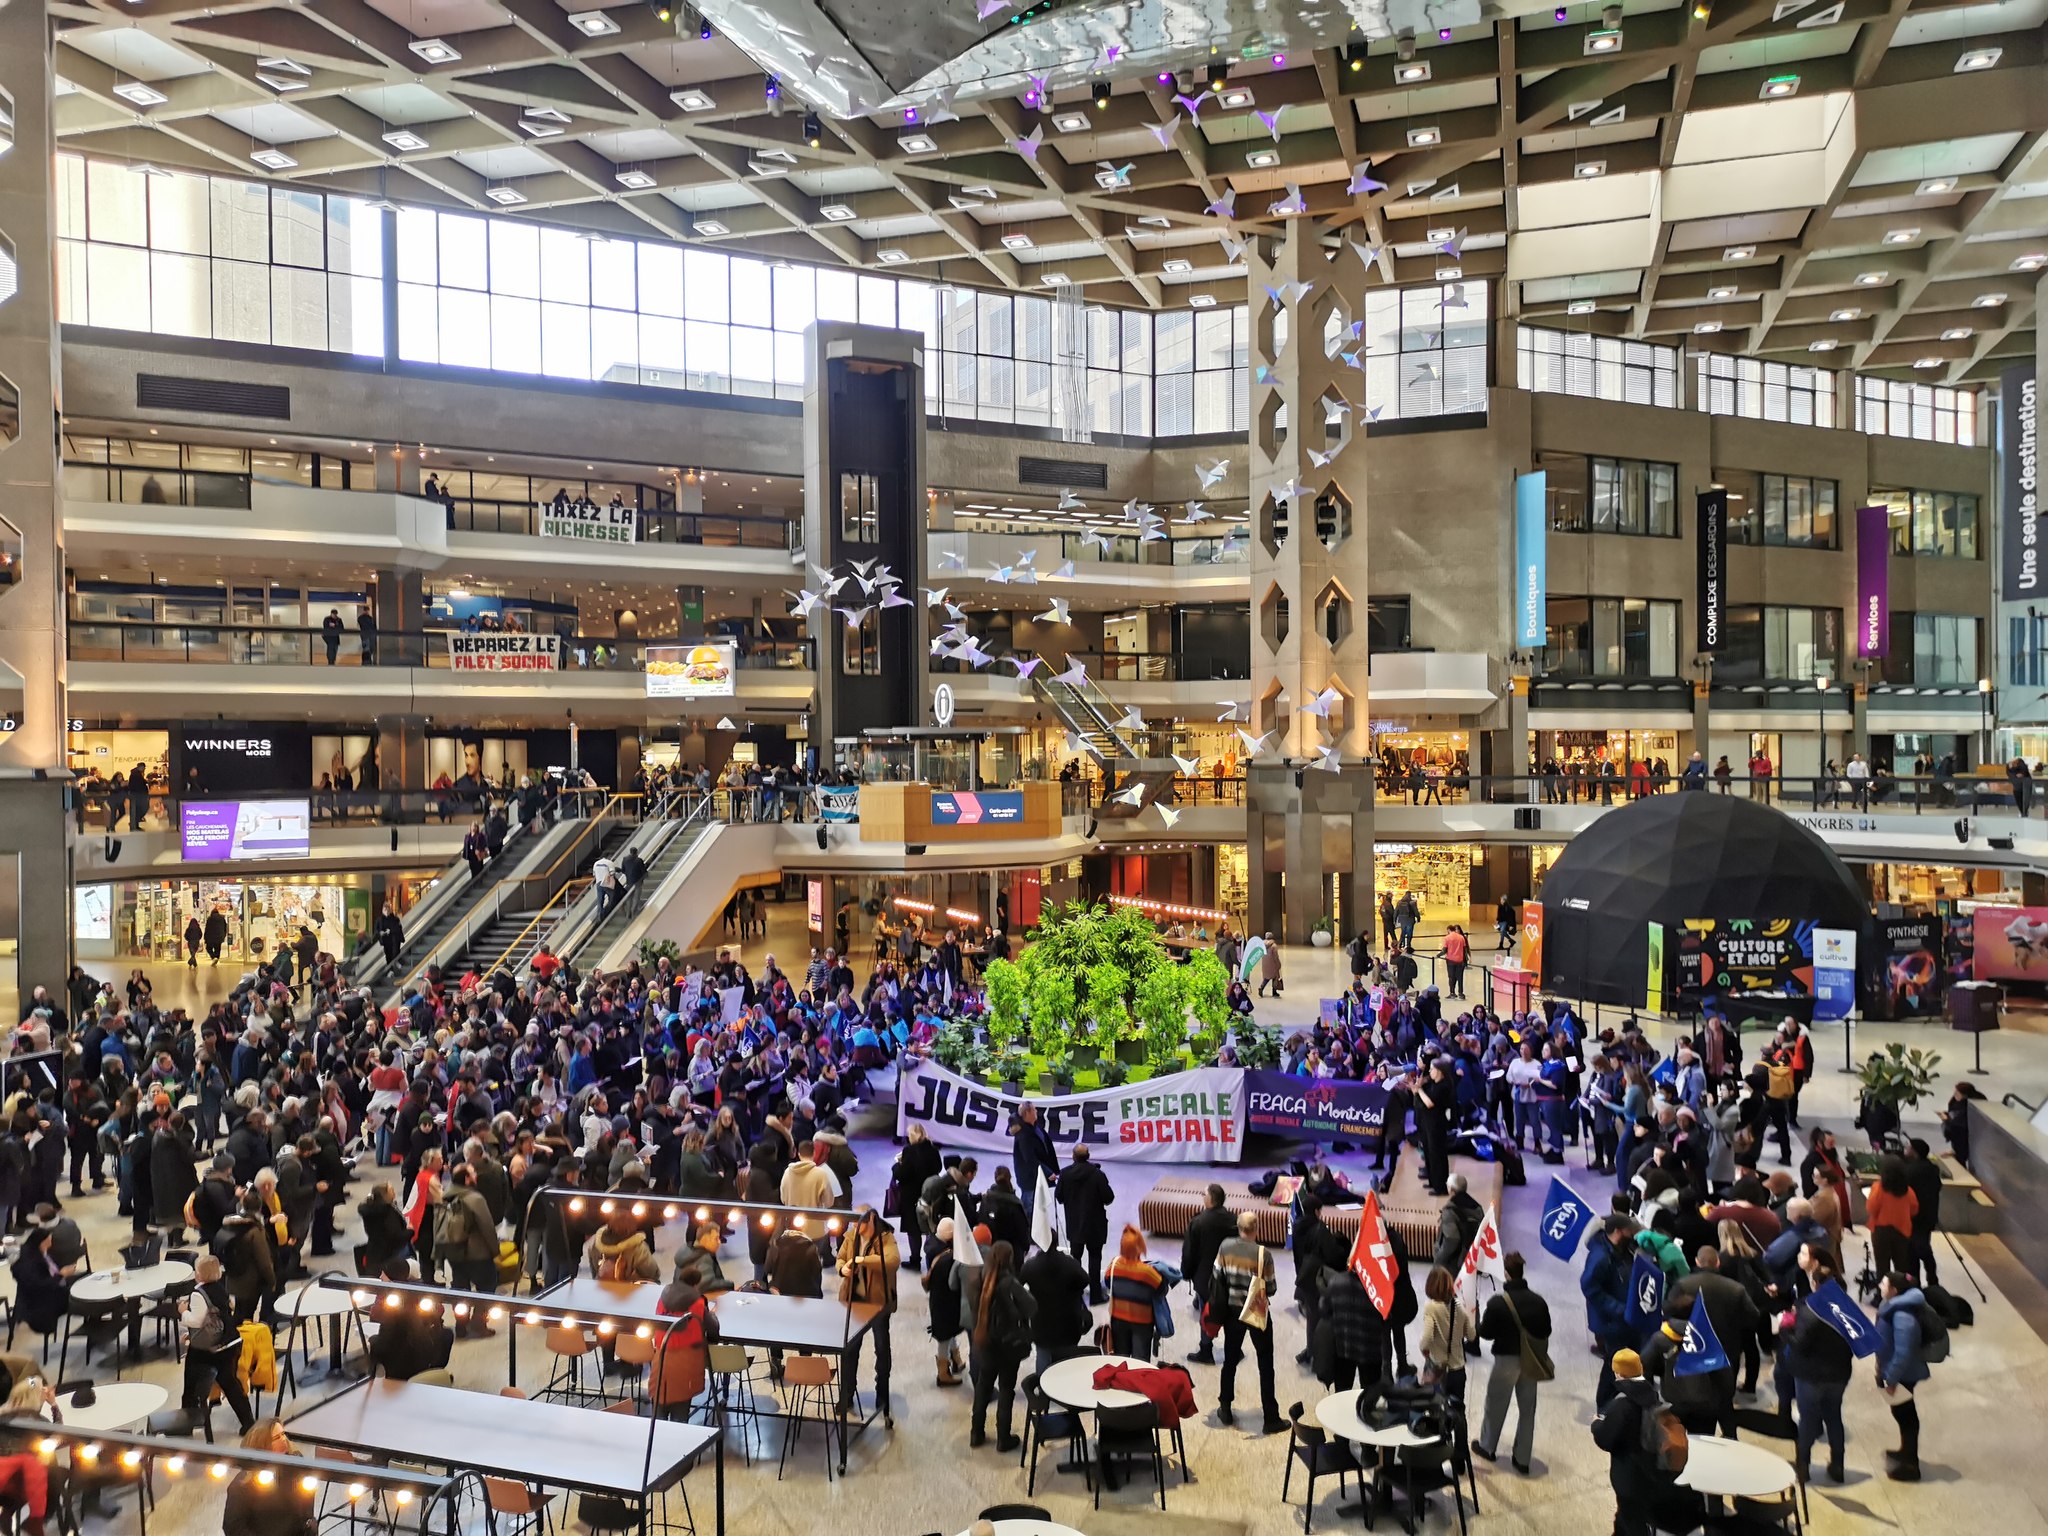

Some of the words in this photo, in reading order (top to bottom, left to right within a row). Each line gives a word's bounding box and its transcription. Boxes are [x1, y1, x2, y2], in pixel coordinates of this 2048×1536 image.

[2018, 378, 2036, 491] destination
[542, 503, 601, 521] TAXEZ
[609, 507, 633, 525] LA
[2019, 493, 2036, 546] seule
[544, 520, 630, 542] RICHESSE
[1707, 503, 1718, 578] DESJARDINS
[2019, 548, 2037, 589] Une
[1526, 564, 1540, 639] Boutiques
[1707, 580, 1718, 645] COMPLEXE
[1867, 595, 1879, 650] Services
[536, 637, 556, 653] LE
[455, 655, 496, 670] FILET
[501, 655, 554, 670] SOCIAL
[185, 739, 272, 750] WINNERS
[1718, 940, 1785, 953] CULTURE
[1819, 953, 1848, 962] cultive
[1727, 953, 1744, 965] ET
[1747, 953, 1776, 966] MOI
[1120, 1092, 1233, 1119] FISCALE
[1249, 1092, 1306, 1114] FRACA
[1318, 1101, 1385, 1124] Montréal
[1120, 1119, 1236, 1143] SOCIALE
[1302, 1119, 1338, 1132] AUTONOMIE
[1354, 1257, 1384, 1309] attac
